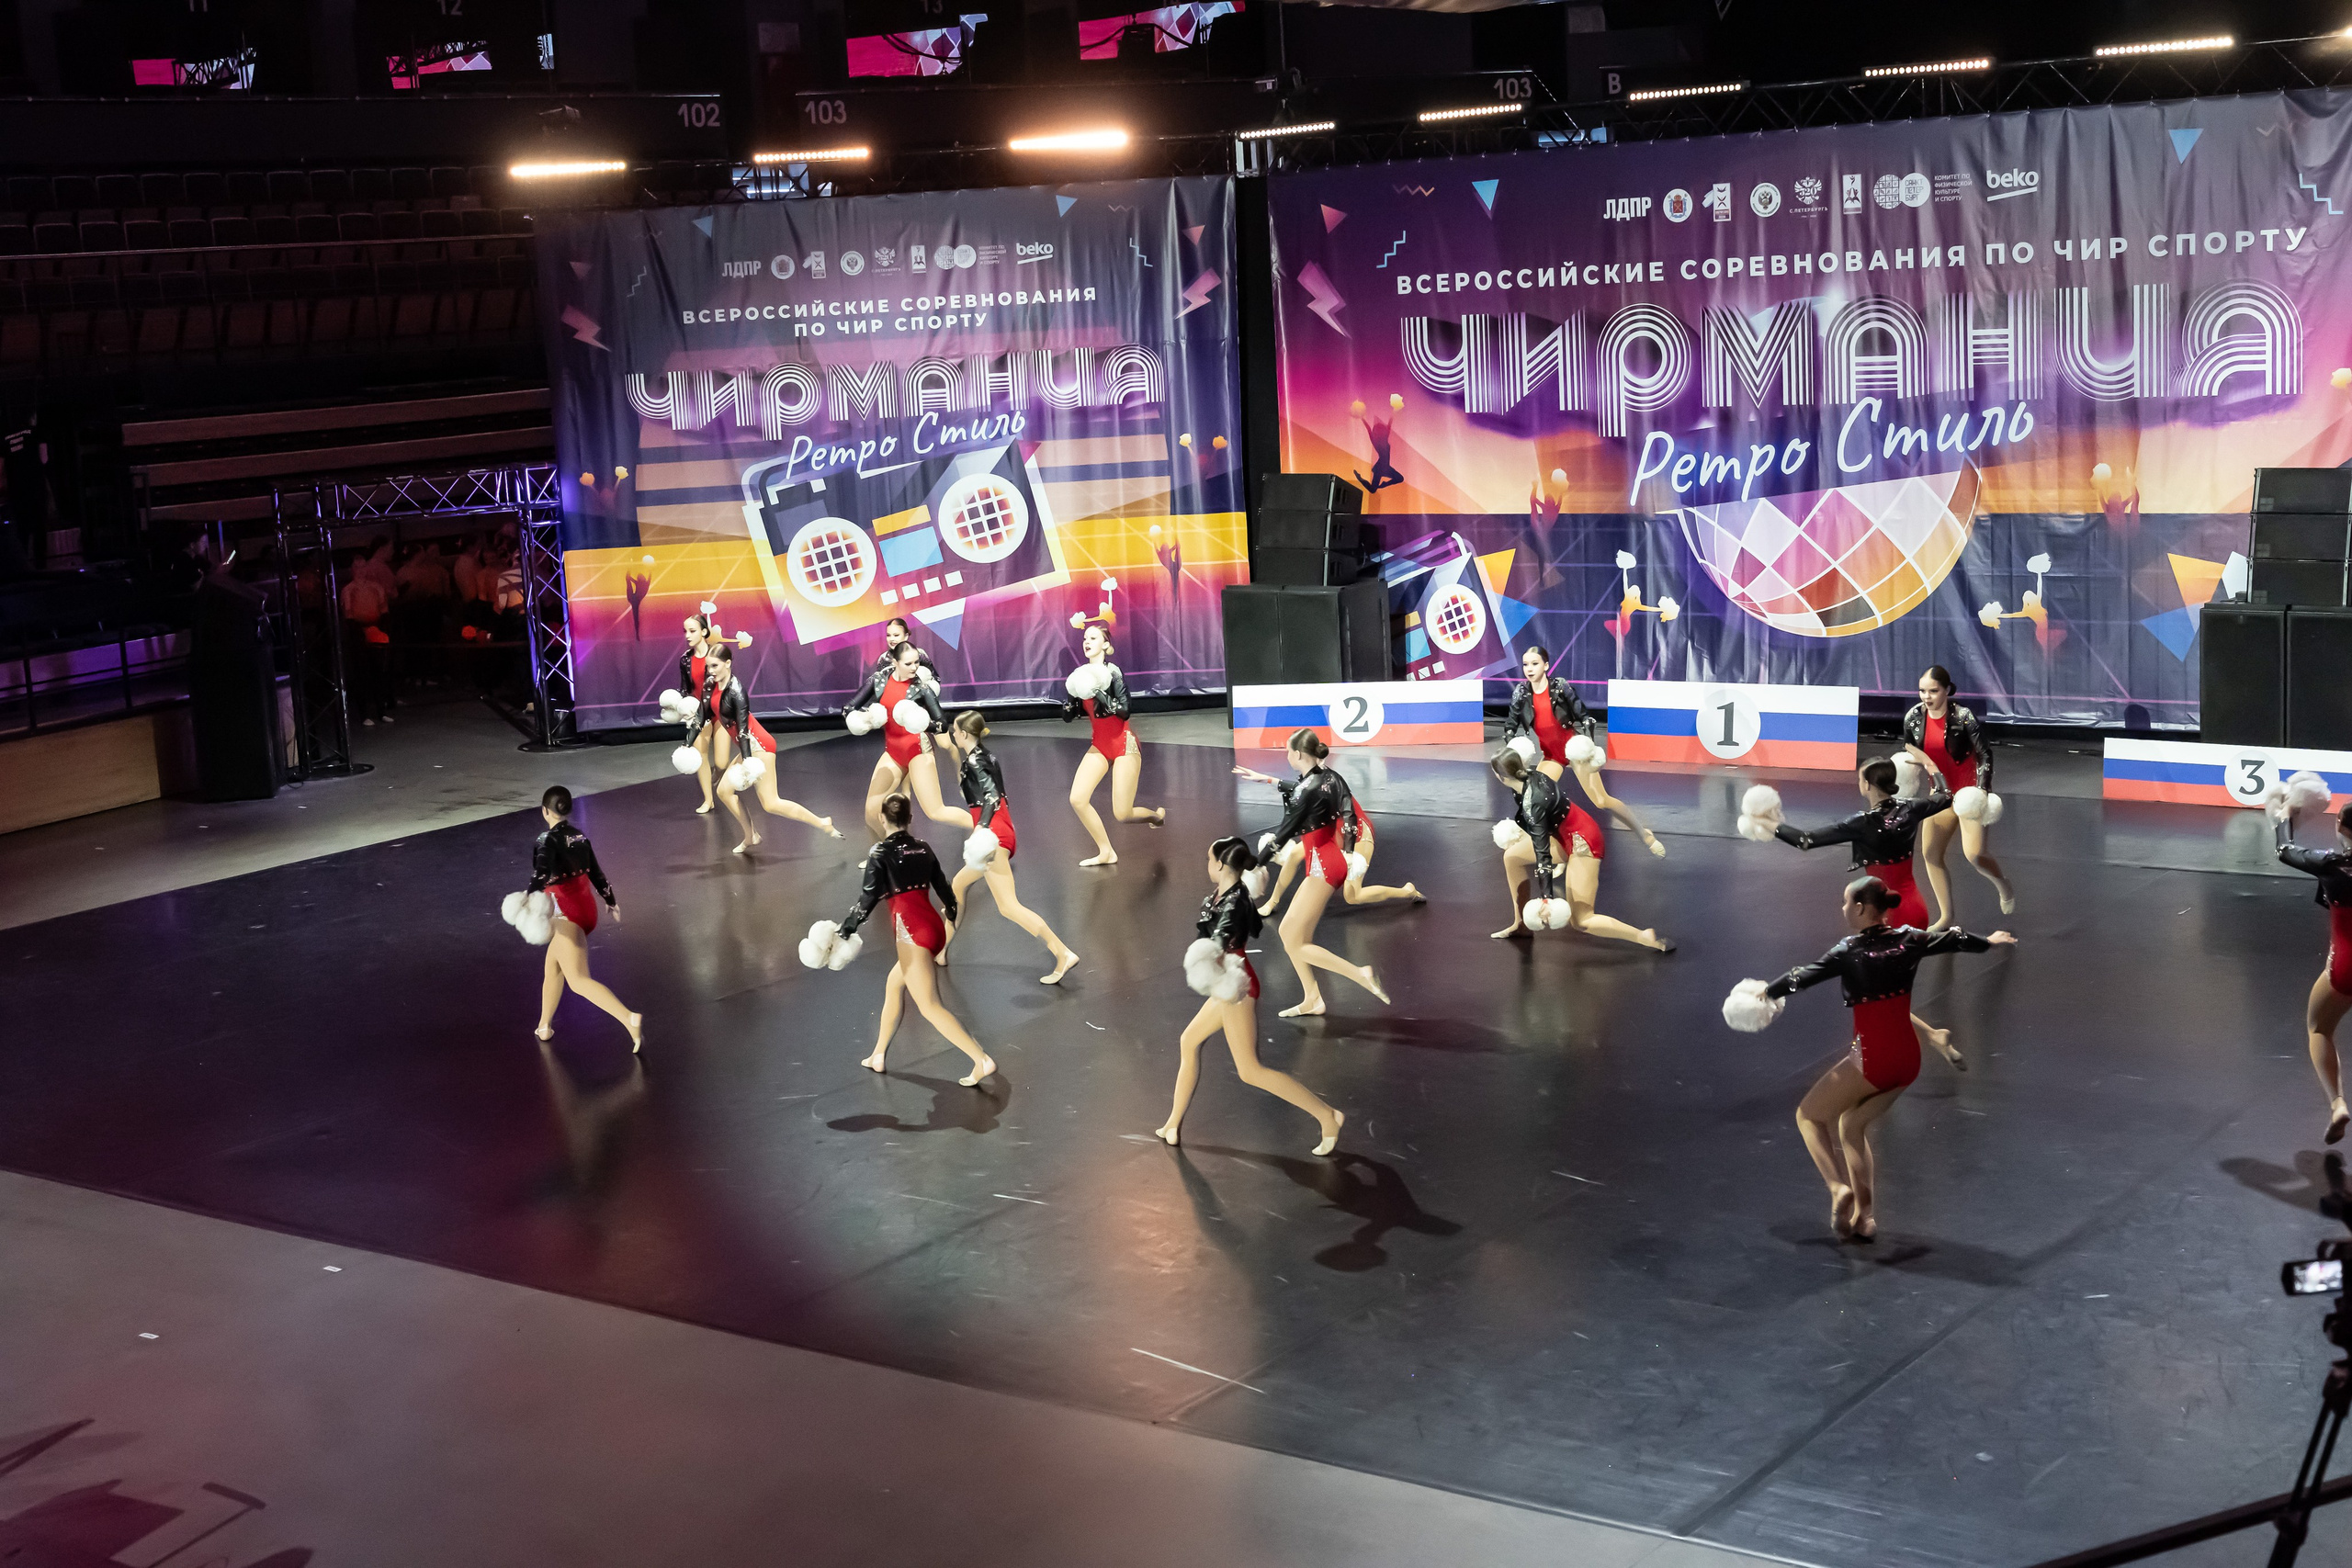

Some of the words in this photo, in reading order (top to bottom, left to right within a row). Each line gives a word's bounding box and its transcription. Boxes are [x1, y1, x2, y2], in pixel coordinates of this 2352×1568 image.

[1493, 76, 1532, 100] 103
[677, 103, 721, 128] 102
[804, 99, 848, 125] 103
[1934, 179, 1973, 187] ФИЗИЧЕСКОЙ
[1985, 168, 2039, 188] beko
[1602, 197, 1652, 222] ЛДПР
[1015, 242, 1054, 256] beko
[1396, 260, 1665, 295] ВСЕРОССИЙСКИЕ
[1680, 244, 1966, 279] СОРЕВНОВАНИЯ
[1985, 242, 2035, 265] ПО
[2053, 236, 2129, 261] ЧИР
[2148, 227, 2308, 257] СПОРТУ
[721, 260, 762, 278] ЛДПР
[683, 299, 890, 325] ВСЕРОССИЙСКИЕ
[900, 287, 1097, 312] СОРЕВНОВАНИЯ
[794, 321, 826, 337] ПО
[836, 319, 884, 336] ЧИР
[894, 312, 988, 333] СПОРТУ
[785, 434, 899, 480] Ретро
[912, 410, 1027, 457] Стиль
[1630, 431, 1811, 504] Ретро
[1836, 396, 2035, 474] Стиль
[1342, 696, 1370, 734] 2
[1715, 701, 1741, 747] 1
[2238, 759, 2266, 795] 3
